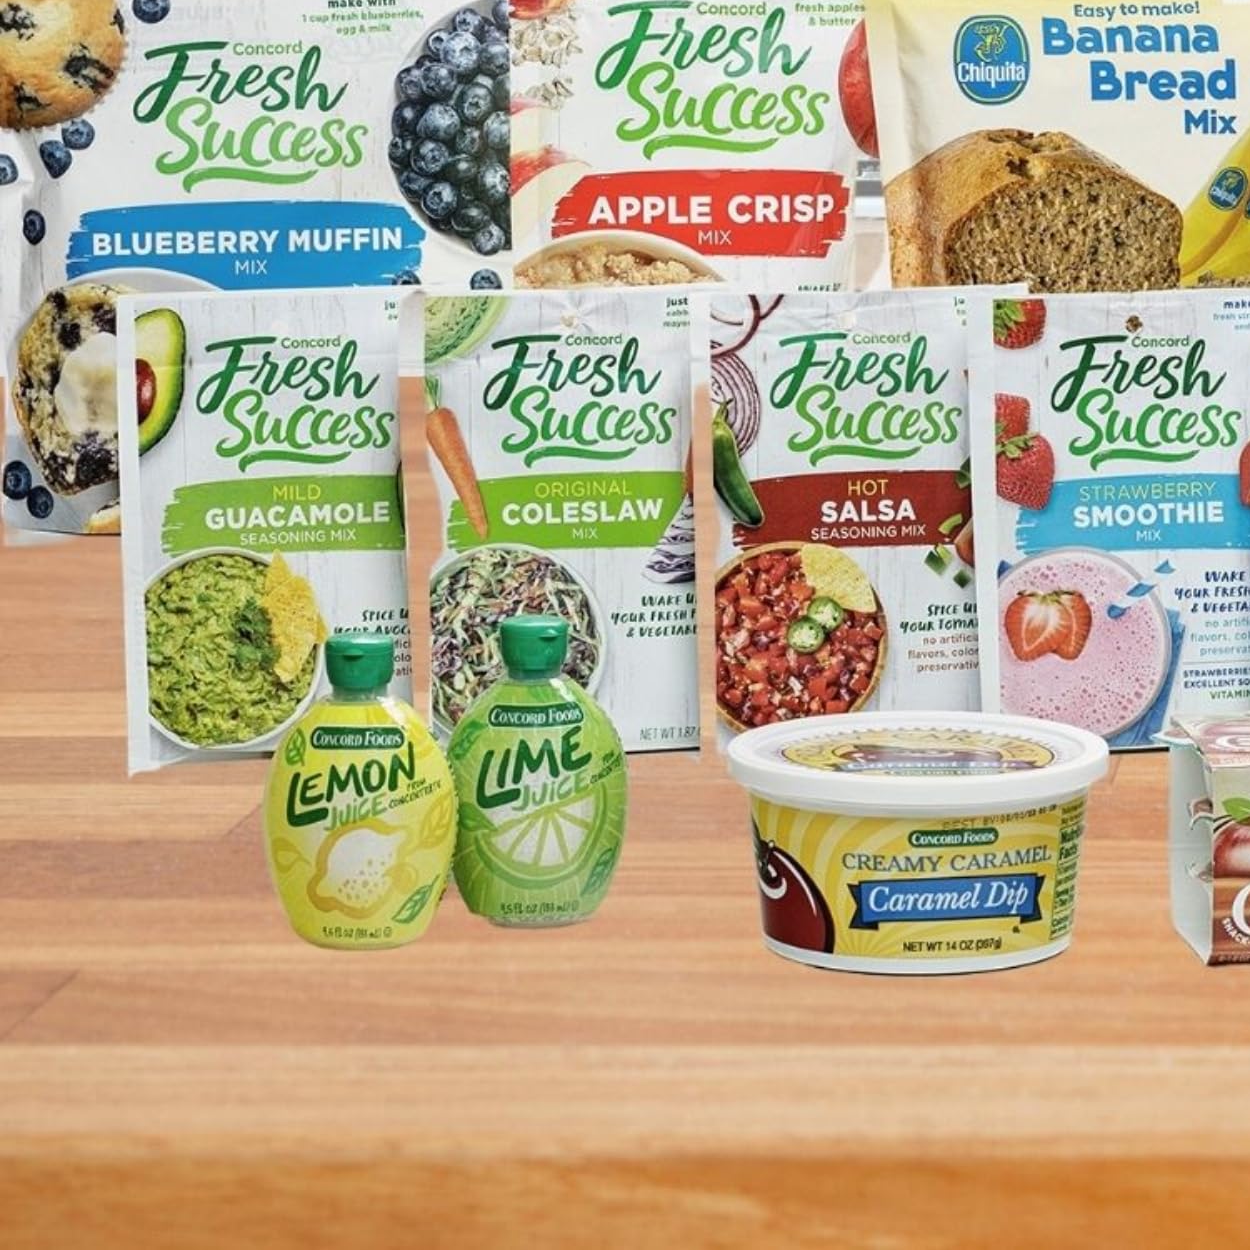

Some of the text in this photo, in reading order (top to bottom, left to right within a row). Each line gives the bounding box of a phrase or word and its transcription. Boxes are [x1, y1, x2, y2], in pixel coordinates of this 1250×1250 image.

[696, 1, 767, 16] Concord
[1074, 1, 1200, 20] Easy to make!
[232, 40, 303, 57] Concord
[595, 0, 813, 90] Fresh
[1042, 17, 1219, 55] Banana
[133, 40, 349, 124] Fresh
[957, 59, 1027, 89] Chiquita
[1090, 59, 1237, 101] Bread
[616, 61, 831, 142] Success
[1184, 109, 1237, 135] Mix
[155, 97, 369, 176] Success
[588, 193, 835, 225] APPLE CRISP
[92, 227, 403, 257] BLUEBERRY MUFFIN
[698, 229, 732, 246] MIX
[235, 259, 268, 275] MIX
[281, 336, 341, 350] Concord
[564, 333, 623, 346] Concord
[852, 332, 911, 345] Concord
[1131, 335, 1190, 348] Concord
[196, 336, 380, 414] Fresh
[483, 334, 662, 411] Fresh
[770, 333, 950, 409] Fresh
[1050, 335, 1227, 413] Fresh
[215, 389, 395, 458] Success
[501, 385, 677, 454] Success
[787, 384, 962, 452] Success
[1068, 388, 1242, 457] Success
[272, 484, 322, 501] MILD
[534, 480, 632, 499] ORIGINAL
[848, 480, 889, 496] HOT
[1079, 481, 1216, 501] STRAWBERRY
[205, 500, 390, 529] GUACAMOLE
[502, 498, 663, 526] COLESLAW
[820, 499, 916, 523] SALSA
[1073, 501, 1224, 528] SMOOTHIE
[240, 528, 357, 545] SEASONING MIX
[572, 527, 599, 540] MIX
[810, 524, 926, 541] SEASONING MIX
[1136, 530, 1161, 542] MIX
[1204, 571, 1246, 583] WAKE
[641, 594, 682, 608] WAKE
[927, 604, 958, 616] SPICE
[477, 725, 593, 810] LIME
[287, 741, 415, 827] LEMON
[842, 846, 1052, 872] CREAMY CARAMEL
[869, 883, 981, 914] Caramel
[984, 880, 1029, 915] Dip
[903, 939, 974, 952] NET WT OZ
